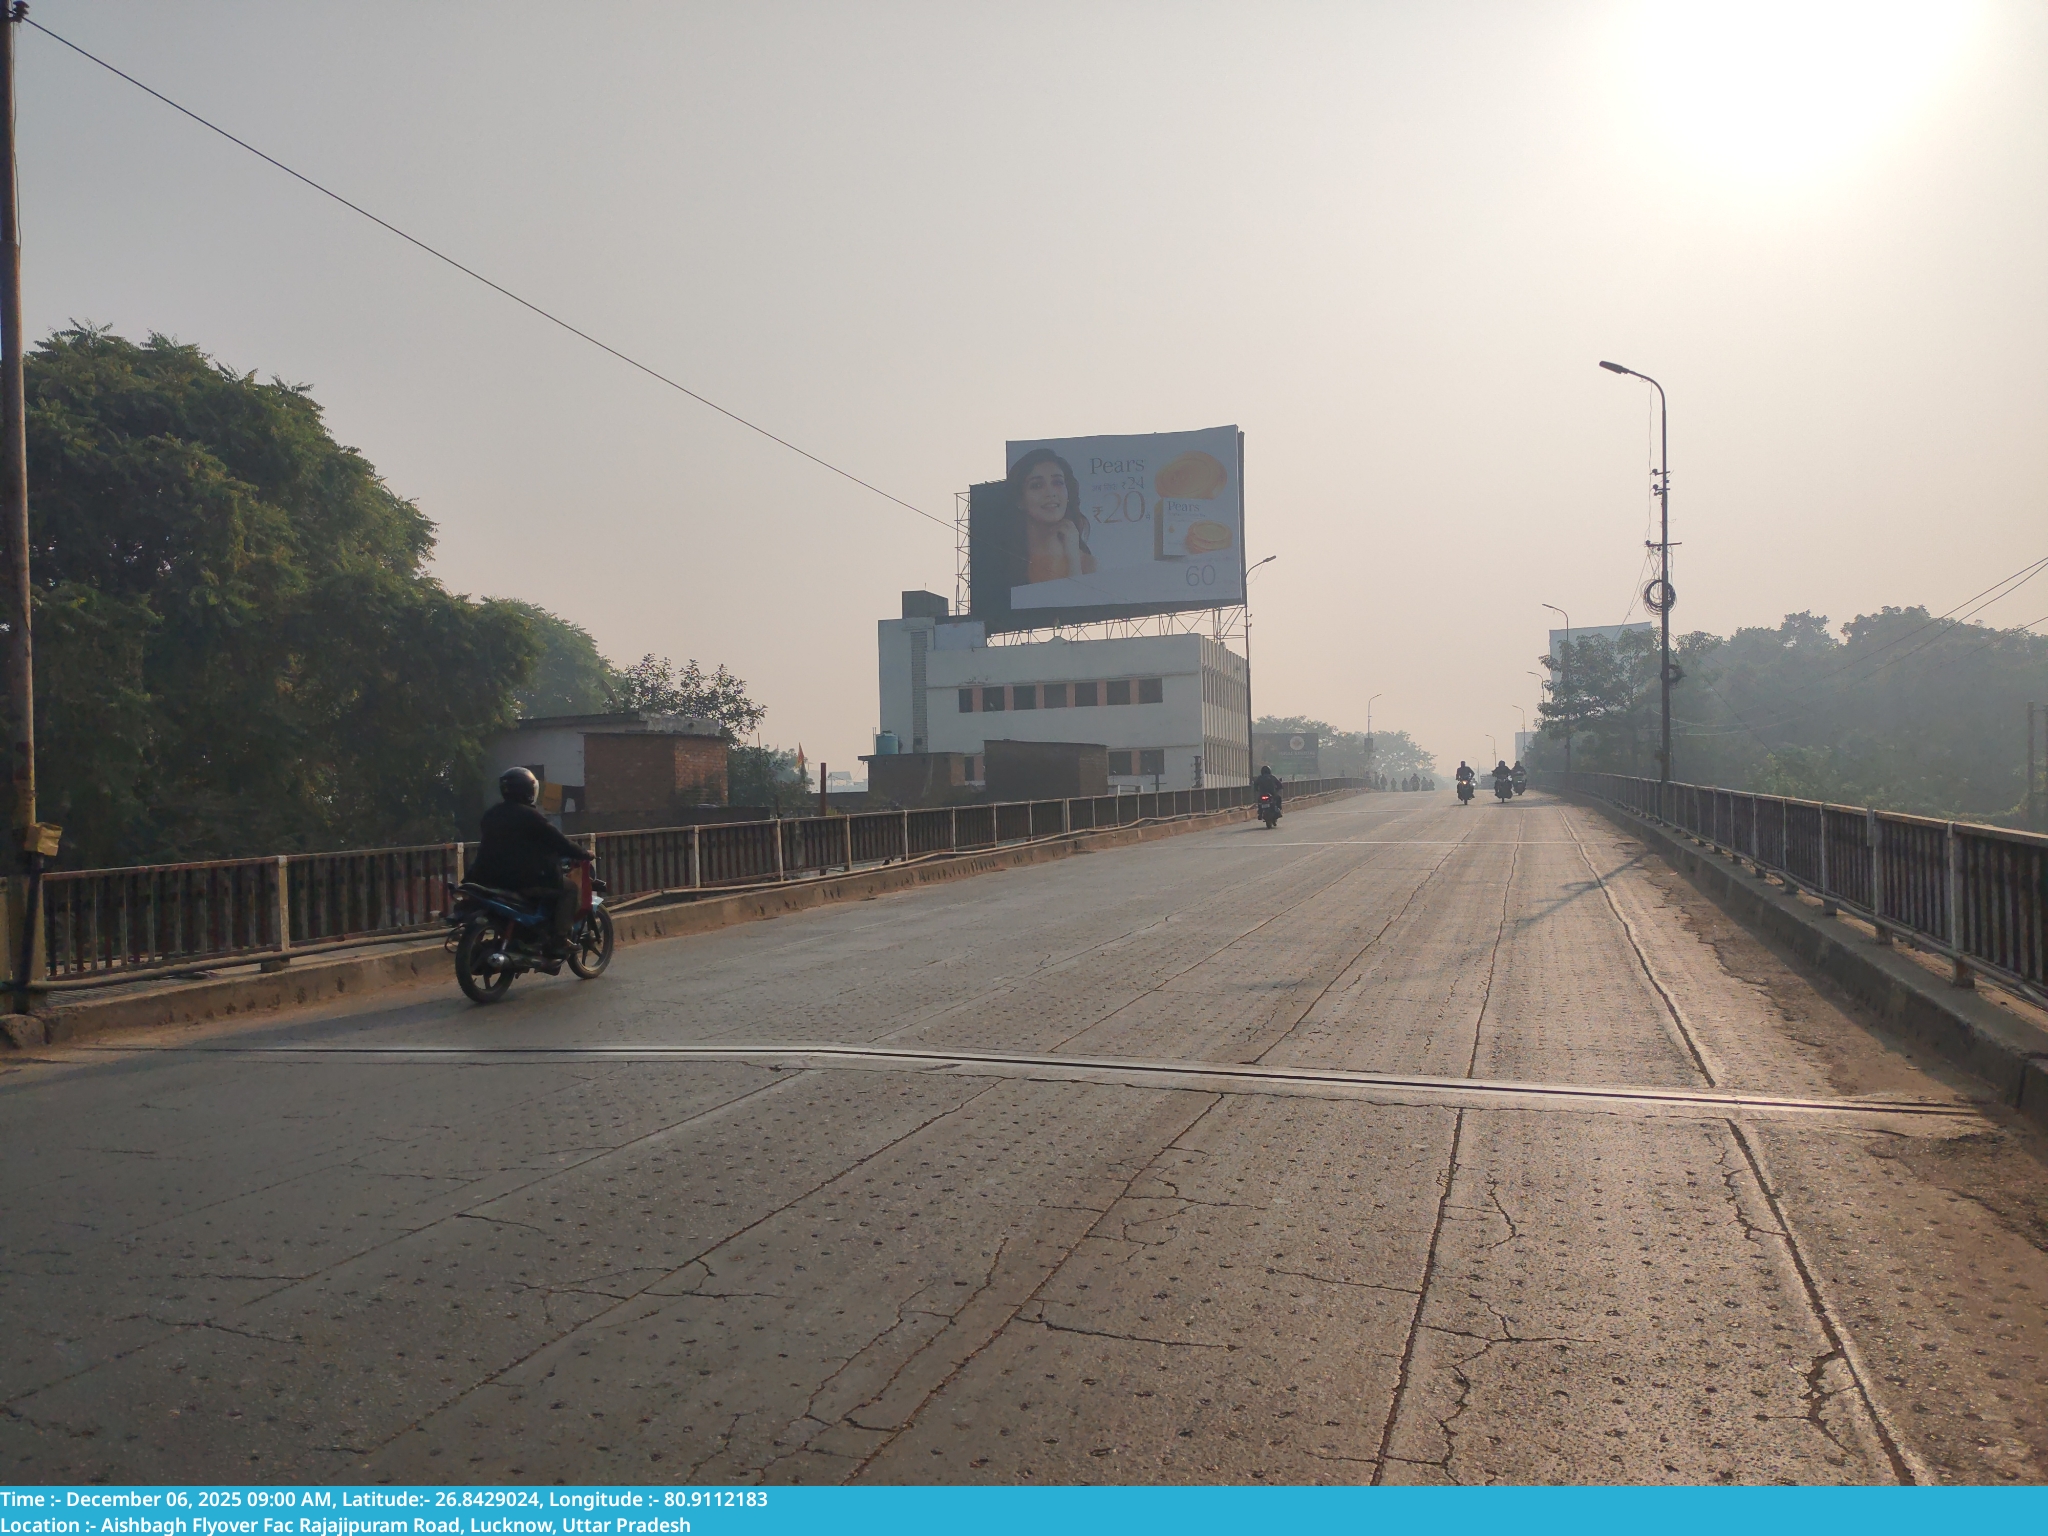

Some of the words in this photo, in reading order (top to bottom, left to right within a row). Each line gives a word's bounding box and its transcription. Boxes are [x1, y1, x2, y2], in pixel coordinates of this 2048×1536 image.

[1090, 457, 1145, 475] Pears
[1092, 490, 1146, 524] ₹20
[1167, 500, 1200, 512] Pears
[1185, 564, 1216, 587] 60
